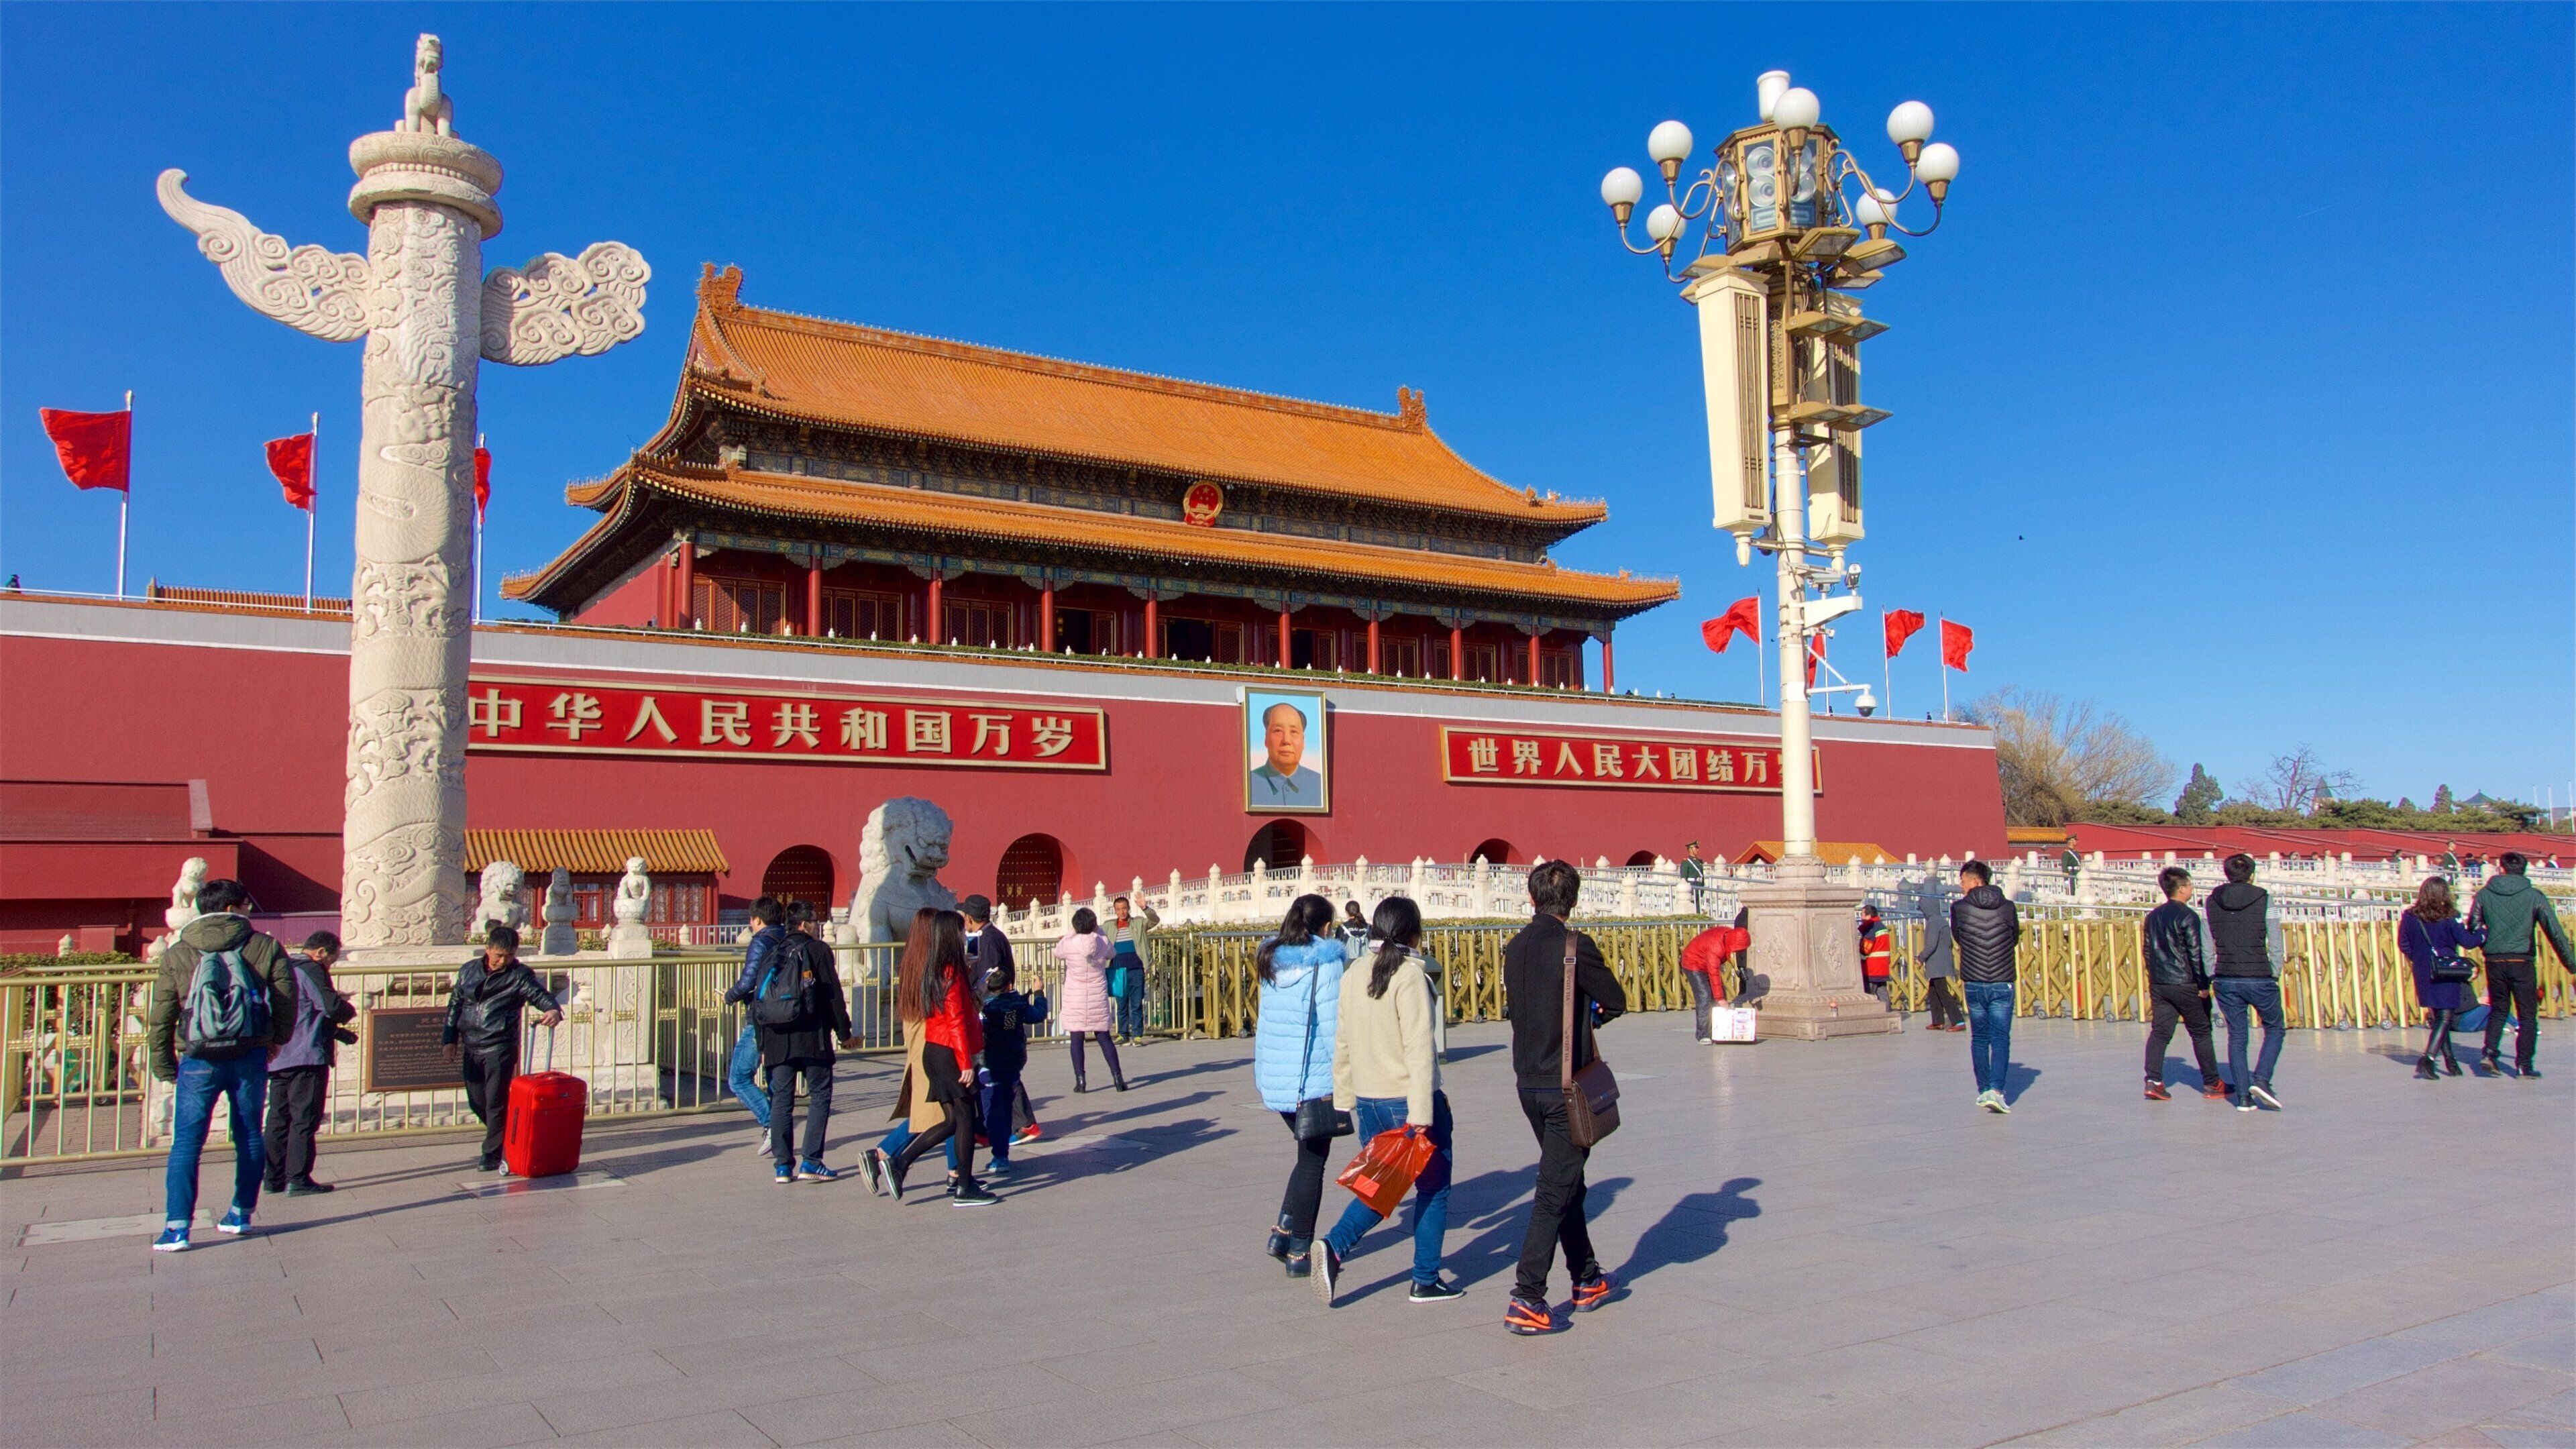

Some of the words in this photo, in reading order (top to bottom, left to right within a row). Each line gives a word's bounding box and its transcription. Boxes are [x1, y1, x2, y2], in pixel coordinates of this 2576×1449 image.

[468, 688, 1074, 757] 中华人民共和国万岁
[1467, 737, 1783, 785] 世界人民大团结万
